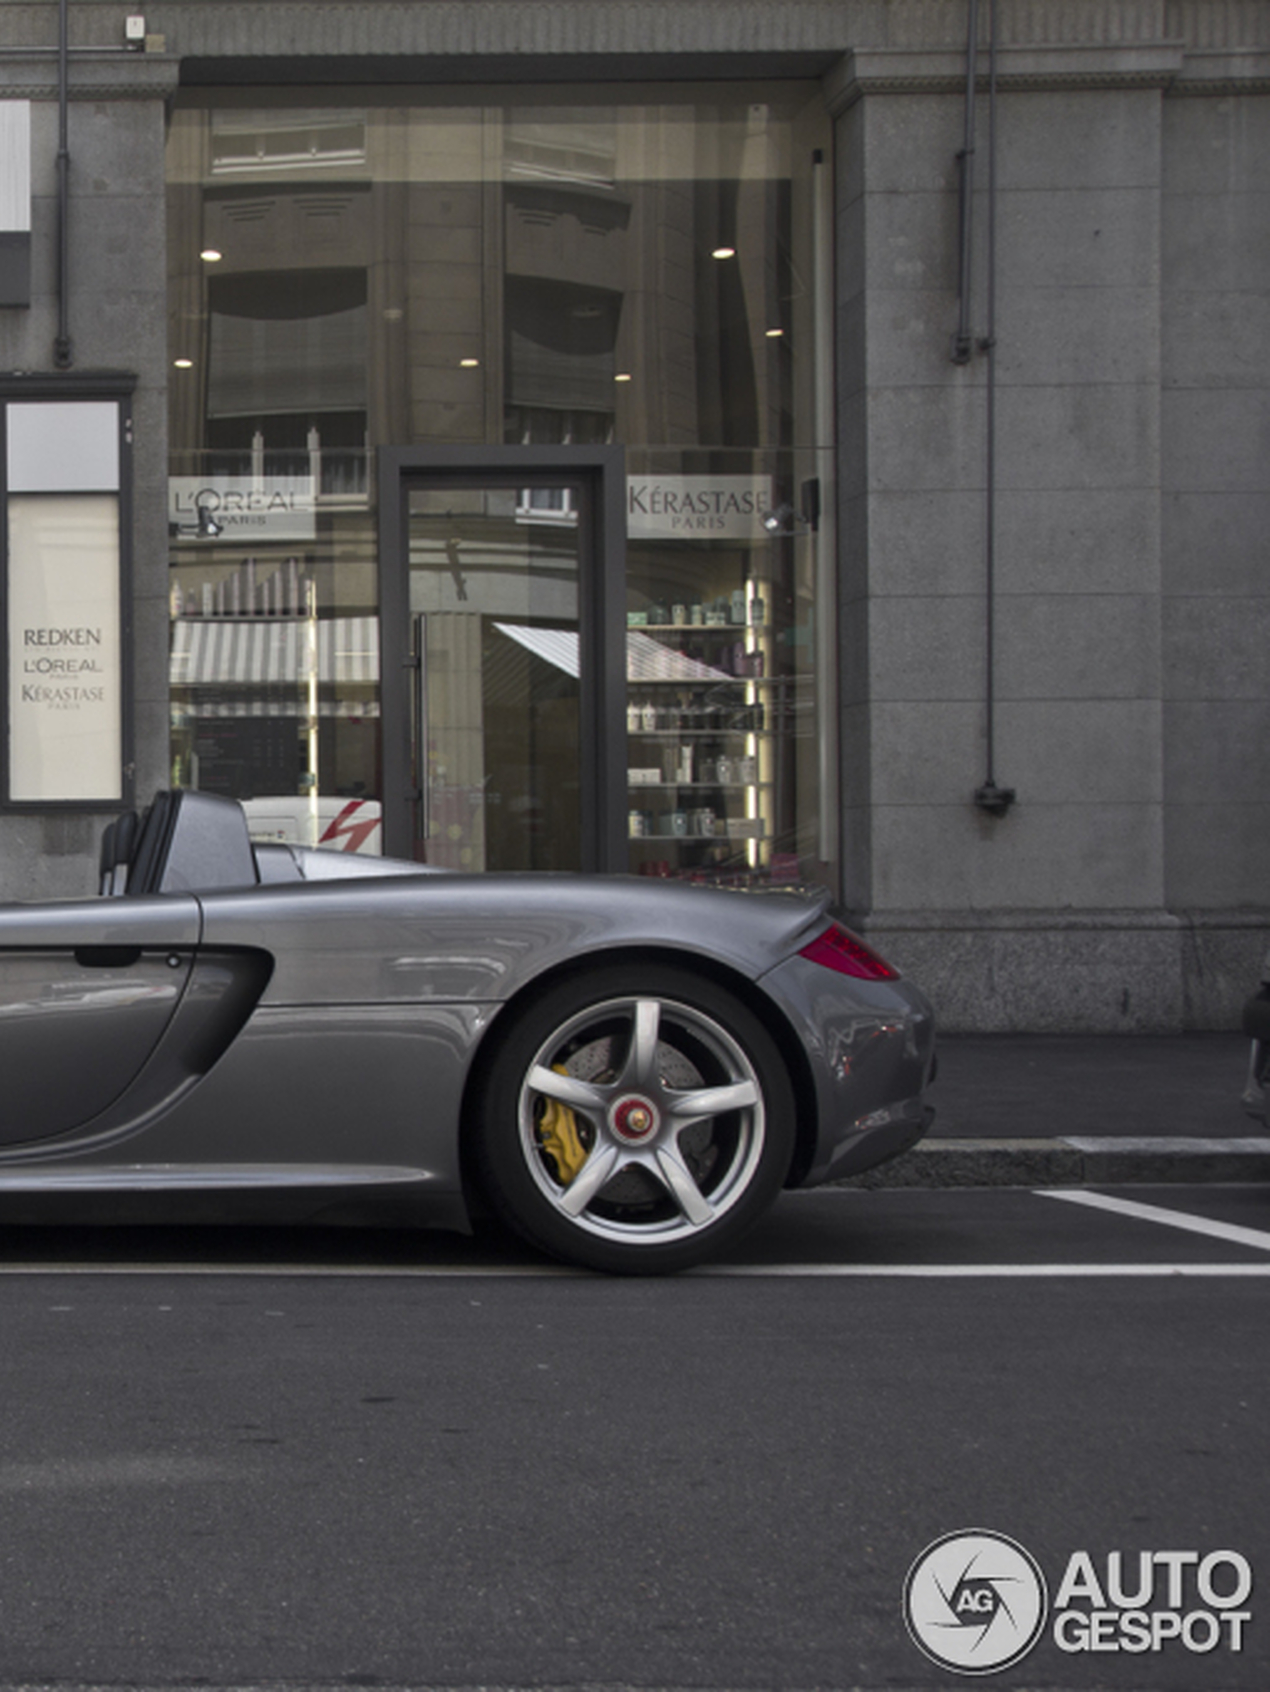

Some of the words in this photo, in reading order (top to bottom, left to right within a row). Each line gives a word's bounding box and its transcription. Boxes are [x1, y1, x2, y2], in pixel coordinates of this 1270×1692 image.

[629, 485, 768, 514] KÉRASTASE
[218, 515, 266, 526] PARIS
[672, 516, 726, 529] PARIS
[24, 627, 101, 646] REDKEN
